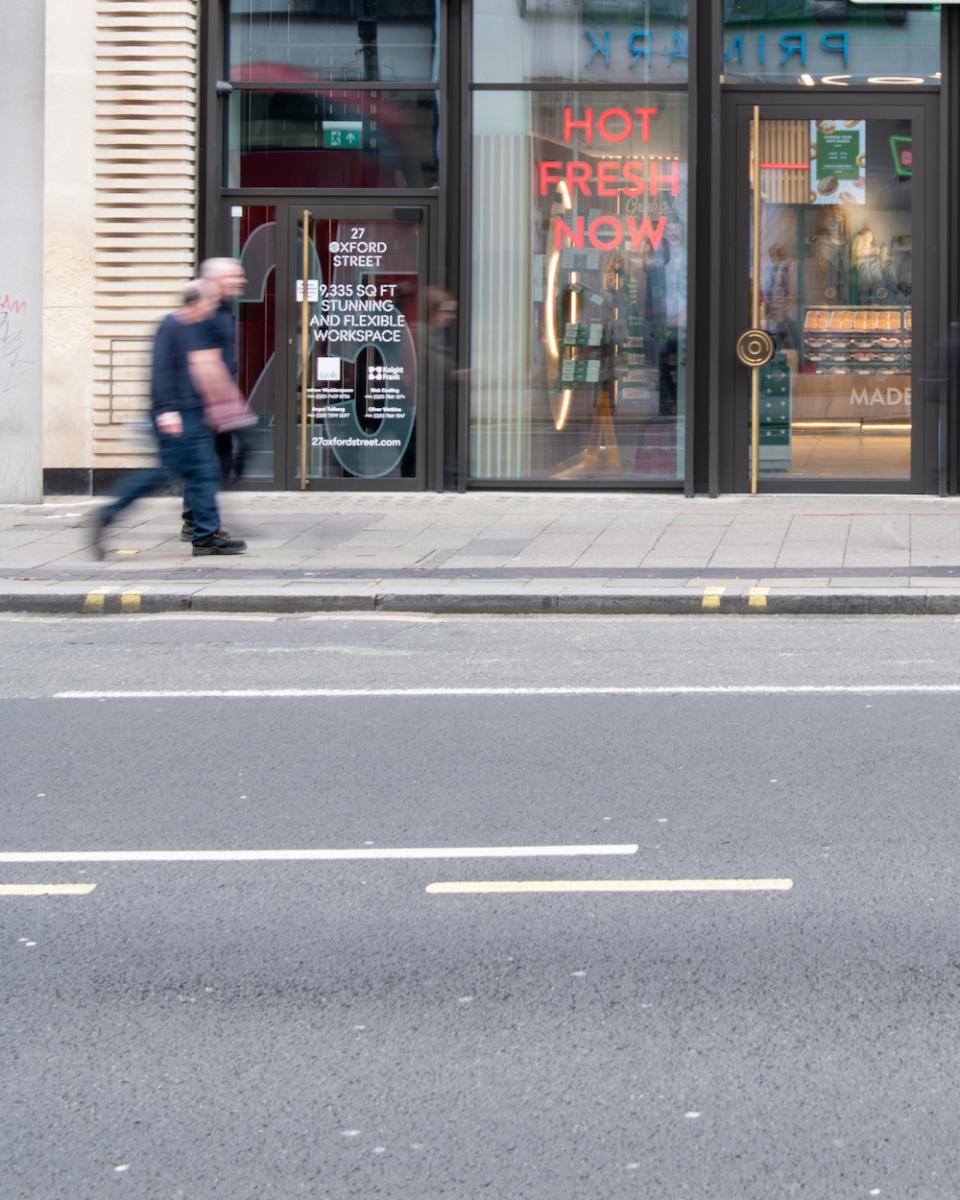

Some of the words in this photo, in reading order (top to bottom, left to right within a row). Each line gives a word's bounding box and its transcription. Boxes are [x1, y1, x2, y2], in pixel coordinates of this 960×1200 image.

[563, 107, 658, 143] HOT
[539, 161, 680, 197] FRESH
[350, 227, 366, 239] 27
[554, 215, 667, 251] NOW
[329, 241, 387, 253] OXFORD
[333, 255, 382, 267] STREET
[319, 285, 354, 298] 9,335
[356, 285, 377, 297] SQ
[380, 285, 397, 297] FT
[321, 300, 394, 312] STUNNING
[309, 315, 341, 327] AND
[344, 315, 406, 327] FLEXIBLE
[313, 330, 401, 342] WORKSPACE
[850, 388, 912, 406] MADE
[311, 437, 402, 447] 27oxfordstreet.com
